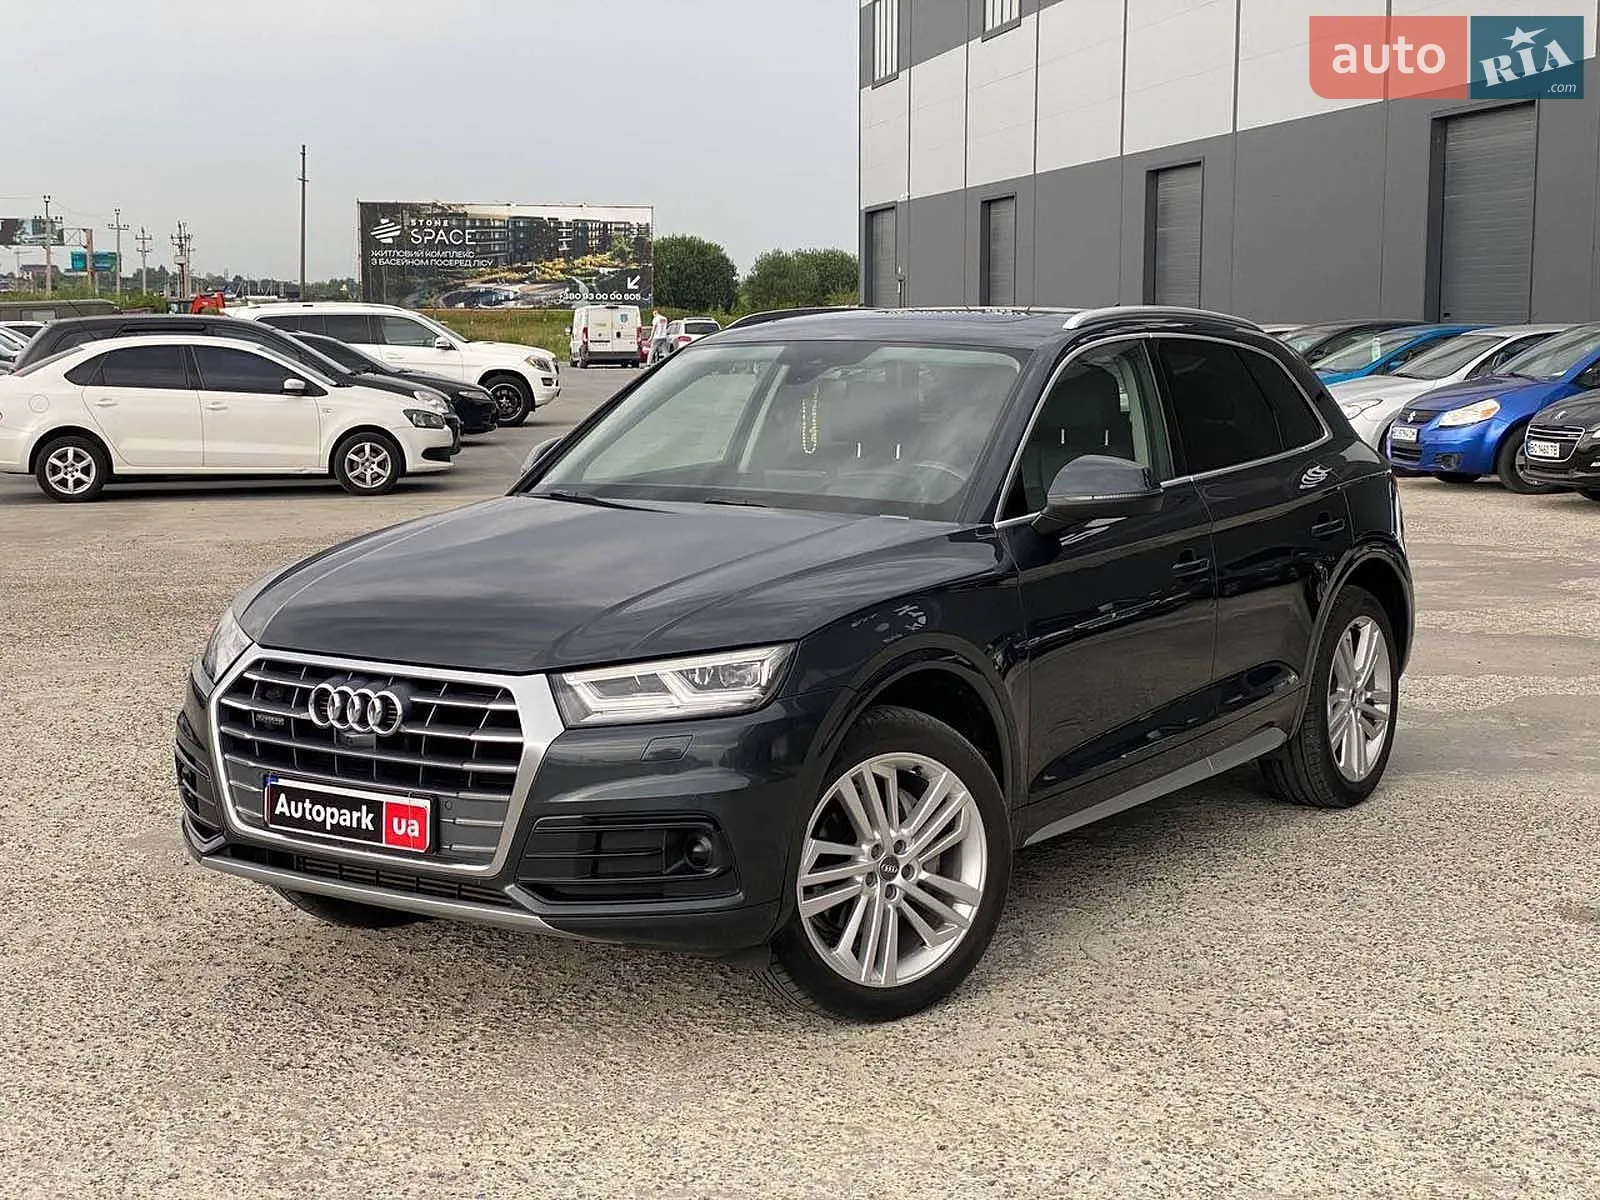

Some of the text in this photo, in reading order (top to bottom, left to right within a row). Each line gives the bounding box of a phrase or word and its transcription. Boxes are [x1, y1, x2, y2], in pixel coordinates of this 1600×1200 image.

[410, 219, 449, 227] STONE
[410, 229, 477, 245] SPACE
[370, 249, 476, 258] ЖИТЛОВИЙ КОМПЛЕКС
[379, 258, 430, 267] БАСЕЙНОМ
[430, 259, 471, 268] ПОСЕРЕД
[472, 259, 494, 268] ЛІСУ
[595, 292, 608, 301] 00
[609, 292, 623, 301] 00
[274, 792, 420, 838] Autopark ua
